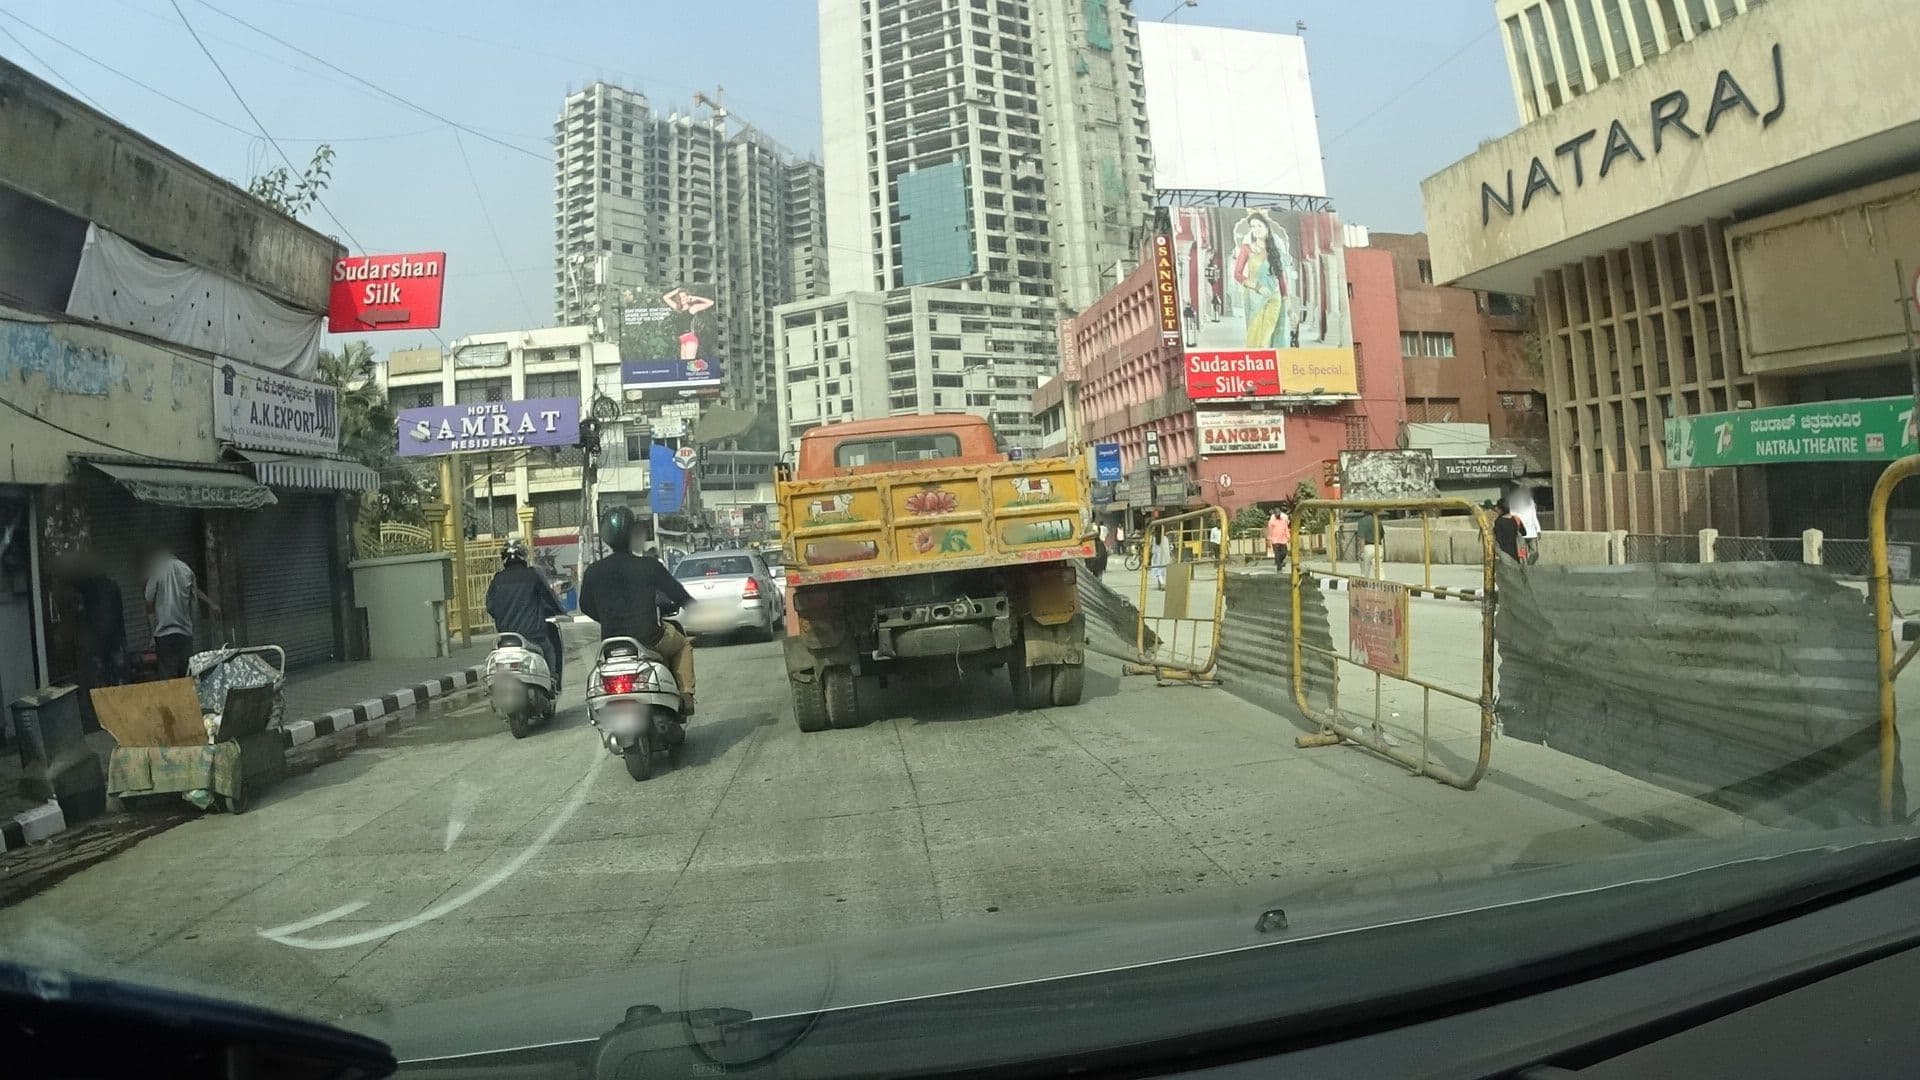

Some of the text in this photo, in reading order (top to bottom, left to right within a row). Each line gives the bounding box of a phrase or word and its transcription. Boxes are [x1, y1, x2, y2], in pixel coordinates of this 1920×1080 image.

[1481, 42, 1786, 227] NATARAJ
[334, 257, 438, 282] Sudarshan
[363, 283, 401, 305] Silk
[1158, 246, 1176, 330] SANGEET
[1189, 354, 1275, 373] Sudarshan
[1292, 364, 1305, 375] Be
[1215, 375, 1255, 394] Silks
[250, 401, 315, 434] A.K.EXPORT
[467, 404, 507, 416] HOTEL
[415, 410, 560, 442] SAMRAT
[1205, 427, 1282, 444] SANGEET
[451, 435, 525, 450] RESIDENCY
[1756, 439, 1800, 456] NATRAJ
[1802, 437, 1858, 453] THEATRE
[680, 448, 693, 457] HP
[1446, 465, 1470, 474] TASTY
